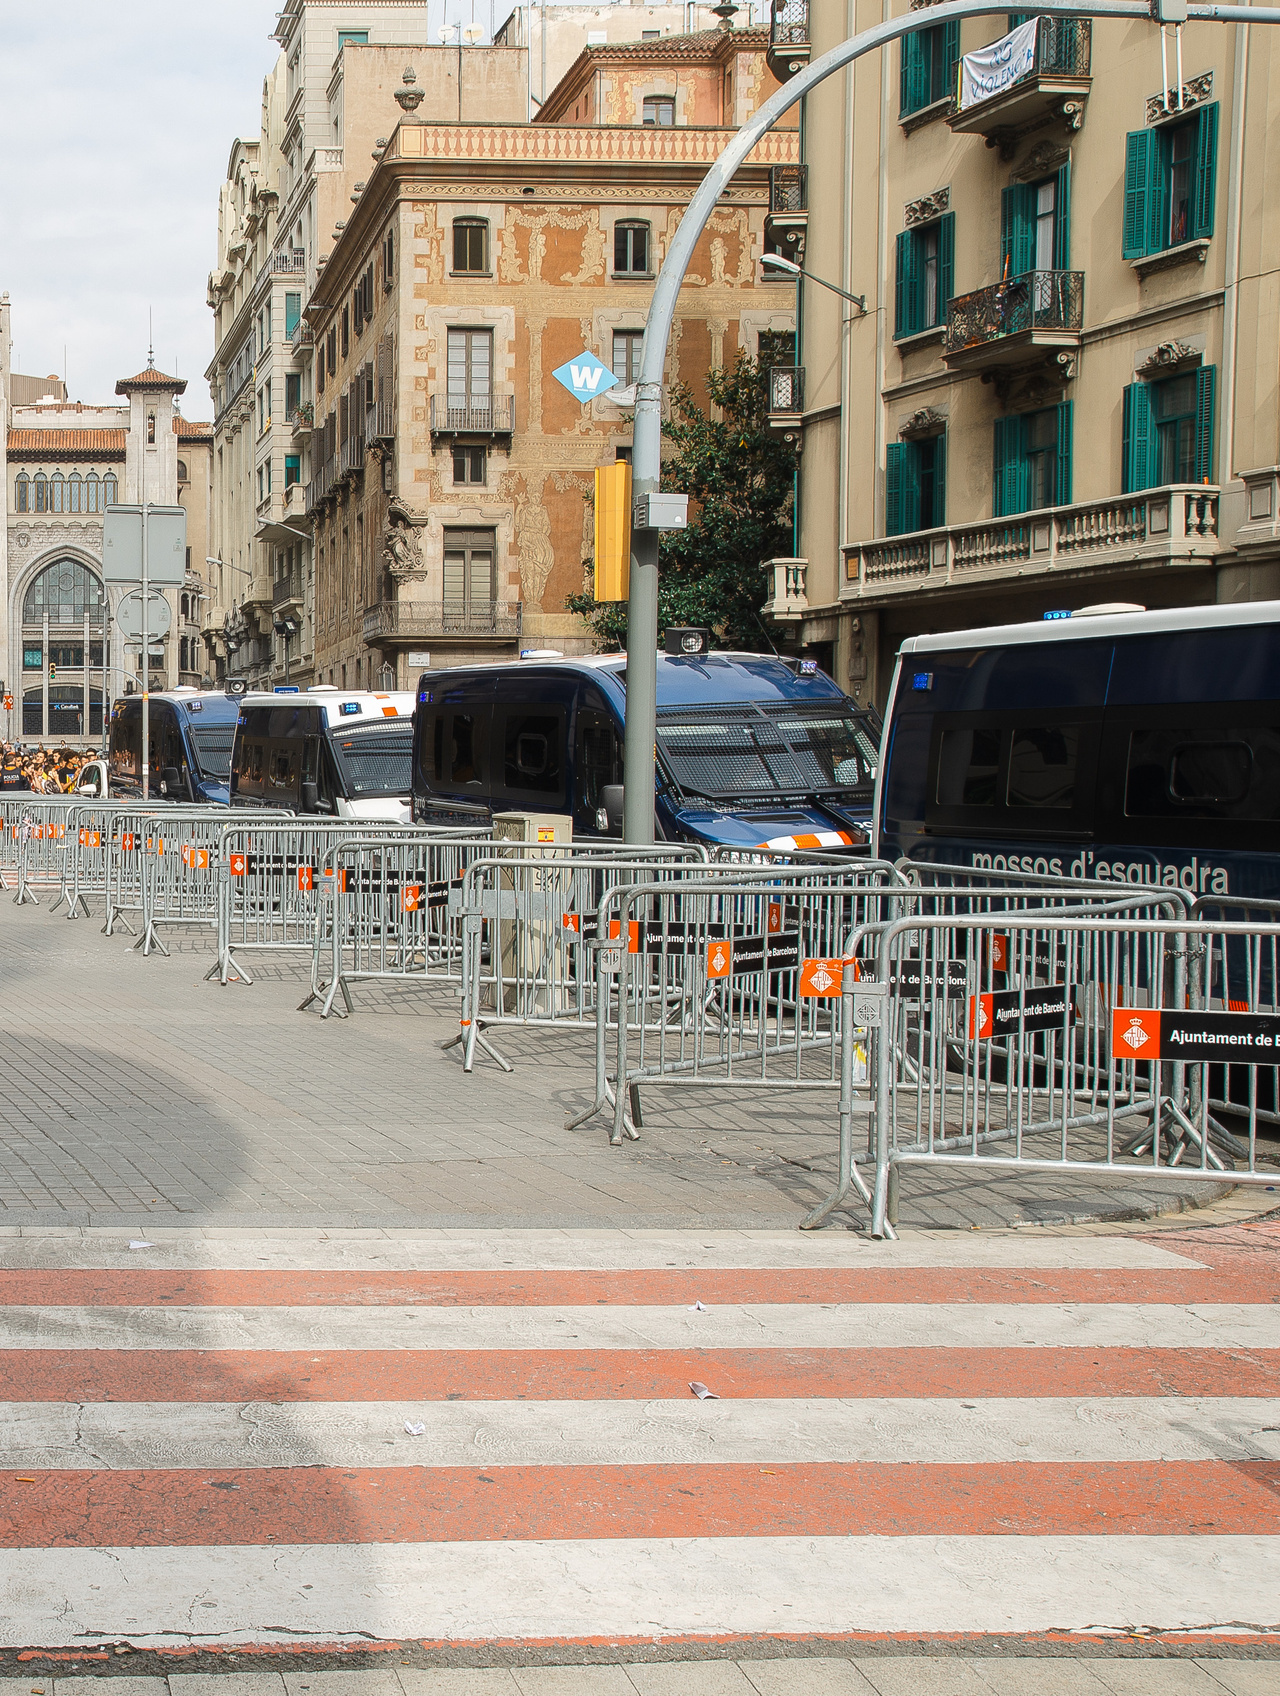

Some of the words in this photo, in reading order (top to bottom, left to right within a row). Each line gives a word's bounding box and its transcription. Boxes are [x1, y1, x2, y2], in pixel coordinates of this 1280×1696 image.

[990, 41, 1013, 68] NO
[569, 365, 604, 390] W
[972, 853, 1063, 877] mossos
[773, 946, 798, 956] Barcelona
[908, 975, 920, 984] de
[1035, 1004, 1042, 1014] de
[1170, 1029, 1253, 1045] Ajuntament
[1255, 1034, 1273, 1046] de
